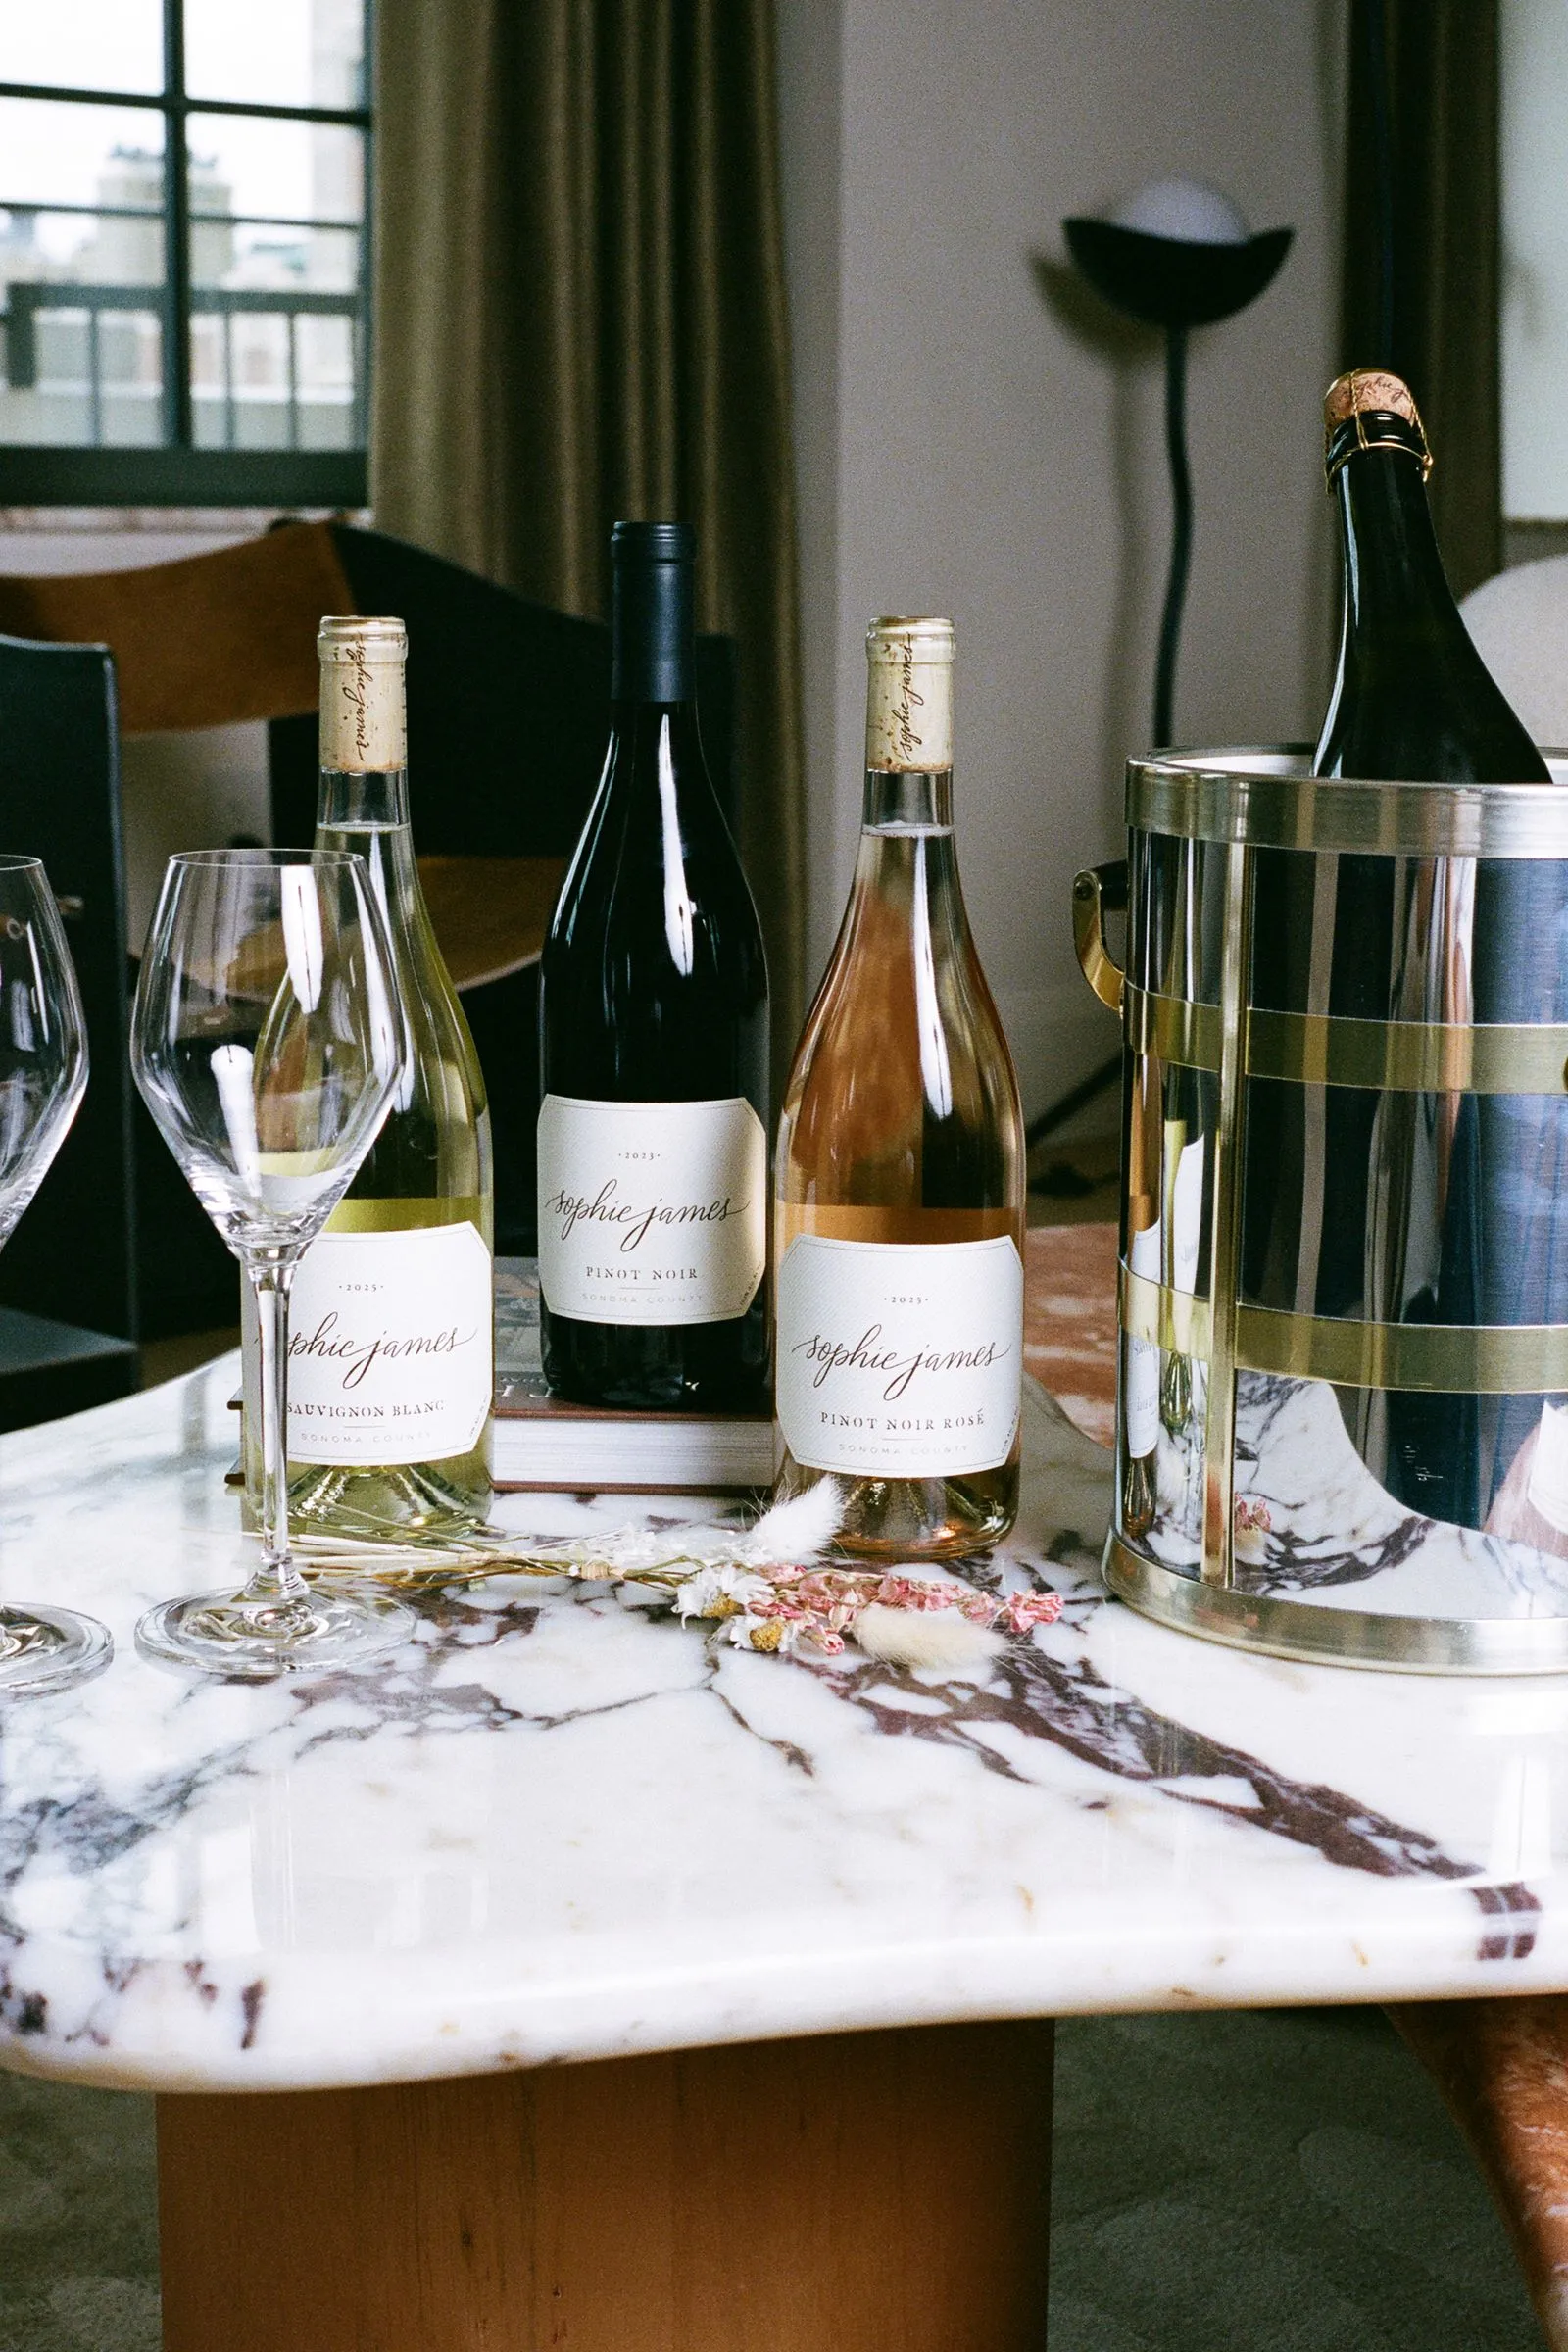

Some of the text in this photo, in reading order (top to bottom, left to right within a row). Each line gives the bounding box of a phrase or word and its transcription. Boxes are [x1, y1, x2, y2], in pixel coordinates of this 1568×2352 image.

[892, 632, 924, 762] sophie james
[343, 686, 370, 761] james
[545, 1179, 751, 1252] sophie james
[586, 1266, 699, 1280] PINOT NOIR
[582, 1293, 637, 1302] SONOMA
[288, 1311, 355, 1358] phie
[343, 1327, 478, 1390] james
[791, 1324, 1012, 1401] sophie james
[287, 1399, 445, 1418] SAUVIGNON BLANC
[821, 1407, 985, 1430] PINOT NOIR ROSÉ
[301, 1433, 364, 1444] SONOMA
[838, 1443, 901, 1455] SONOMA
